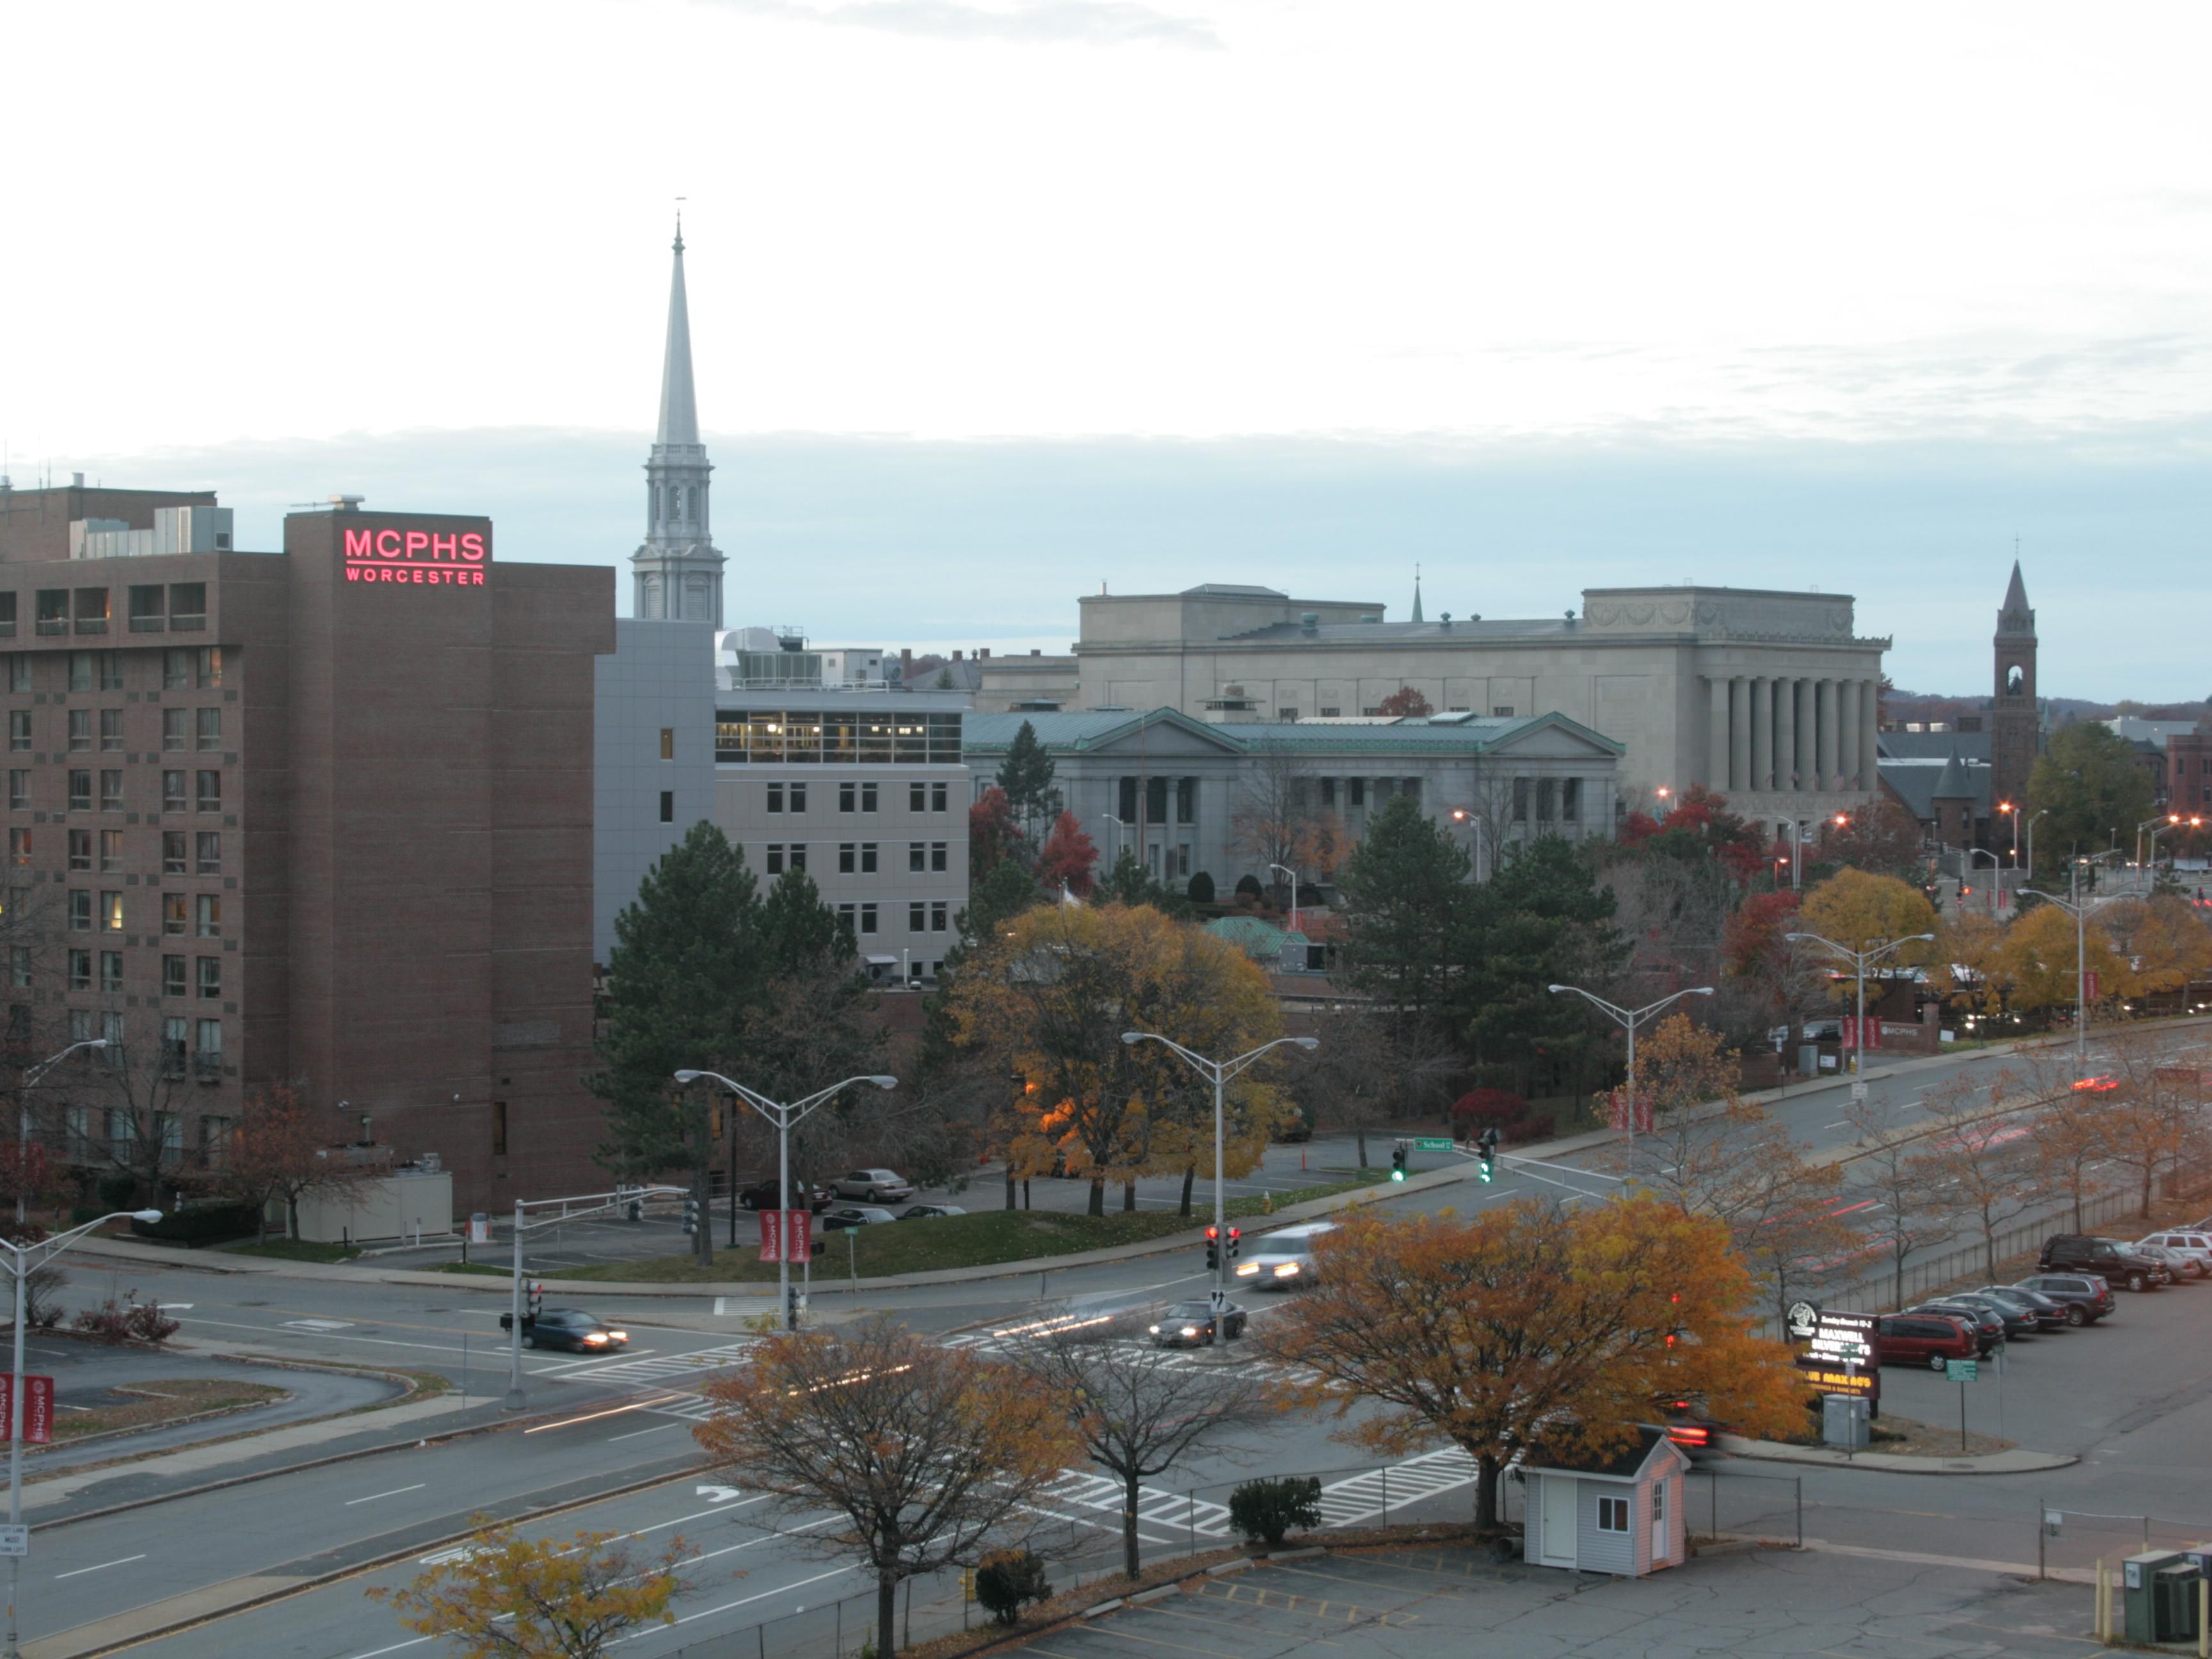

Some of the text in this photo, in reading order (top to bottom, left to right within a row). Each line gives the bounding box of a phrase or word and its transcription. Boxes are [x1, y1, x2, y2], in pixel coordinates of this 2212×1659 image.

[345, 529, 484, 561] MCPHS
[346, 568, 483, 585] WORCESTER
[1888, 1027, 1918, 1036] MCPHS
[1423, 1141, 1445, 1149] School
[1822, 1316, 1839, 1326] Sunday
[1819, 1328, 1864, 1343] MAXWELL
[36, 1396, 45, 1439] MCPHS
